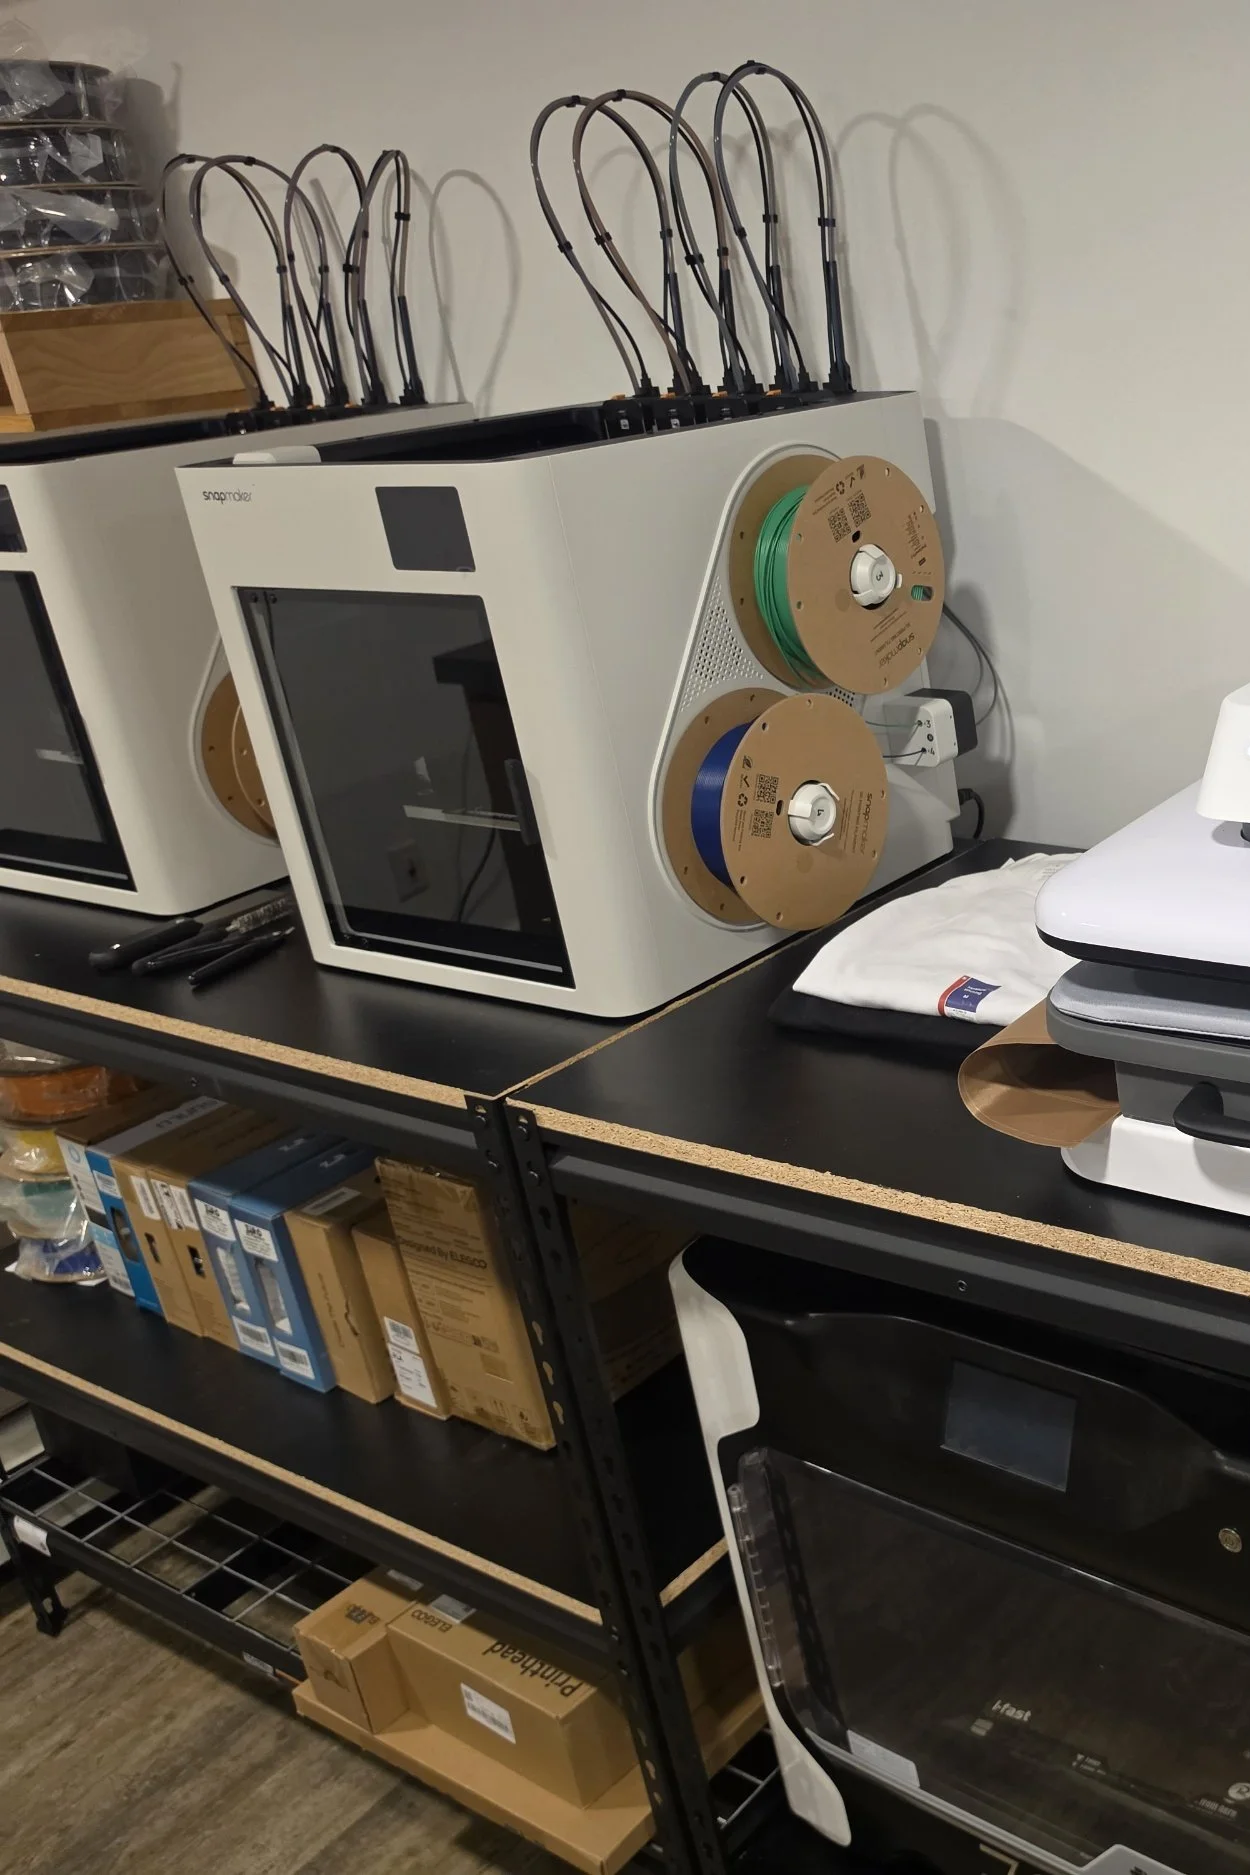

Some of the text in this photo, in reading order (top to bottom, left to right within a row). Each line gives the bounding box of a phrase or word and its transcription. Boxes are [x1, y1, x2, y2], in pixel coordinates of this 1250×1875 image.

[202, 488, 252, 504] snapmaker
[876, 570, 884, 582] 3
[878, 632, 915, 669] snapmaker
[817, 808, 825, 817] 4
[861, 792, 873, 855] snapmaker
[410, 1609, 453, 1633] ELEGOO
[481, 1640, 584, 1698] Printhead
